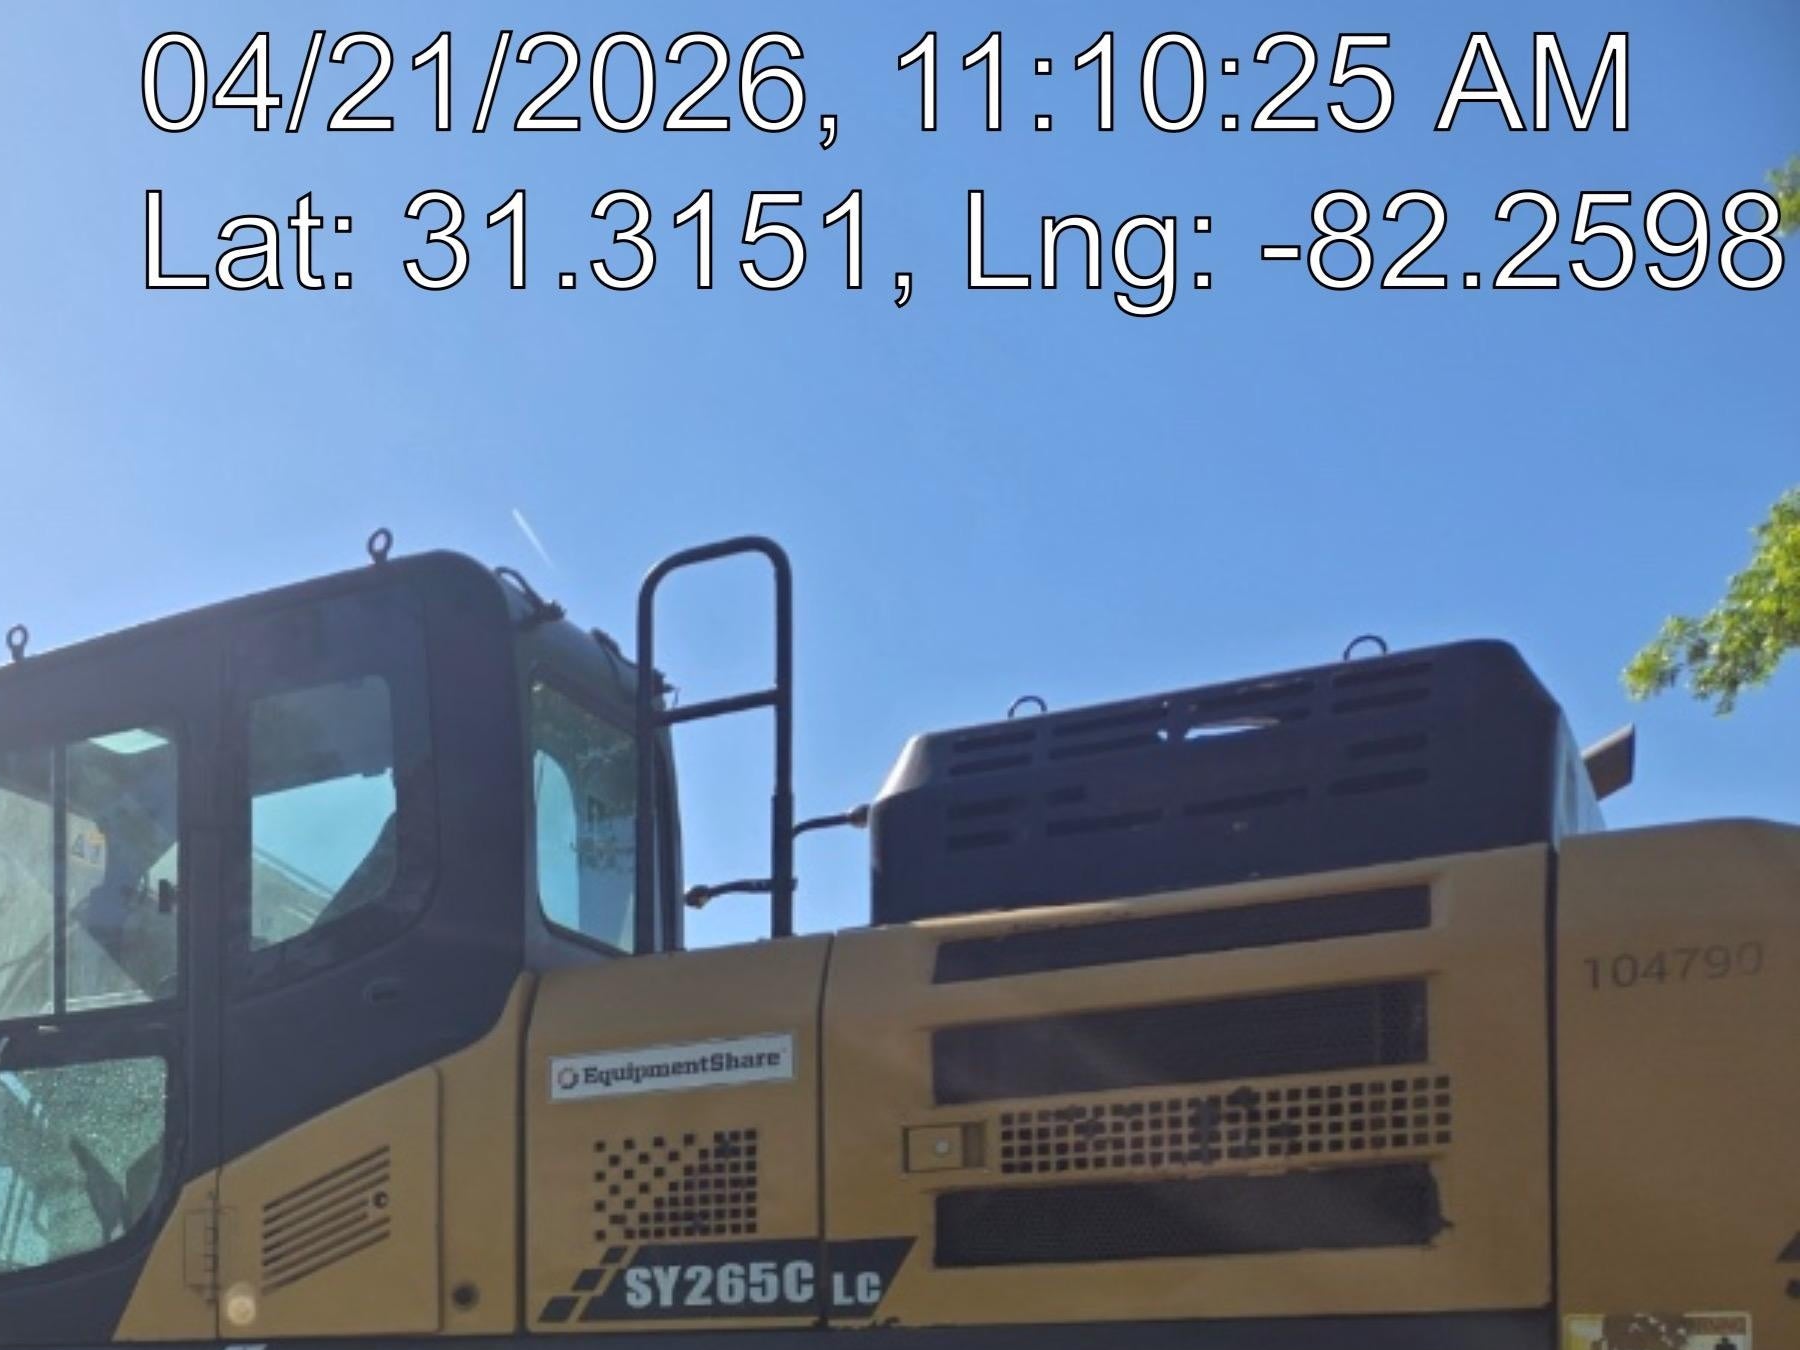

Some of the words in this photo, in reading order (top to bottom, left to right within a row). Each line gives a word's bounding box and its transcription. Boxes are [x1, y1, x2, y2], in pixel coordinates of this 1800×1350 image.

[1583, 940, 1765, 991] 104790
[583, 1051, 781, 1087] EquipmentShare
[624, 1260, 816, 1308] SY265C
[832, 1271, 882, 1306] LC
